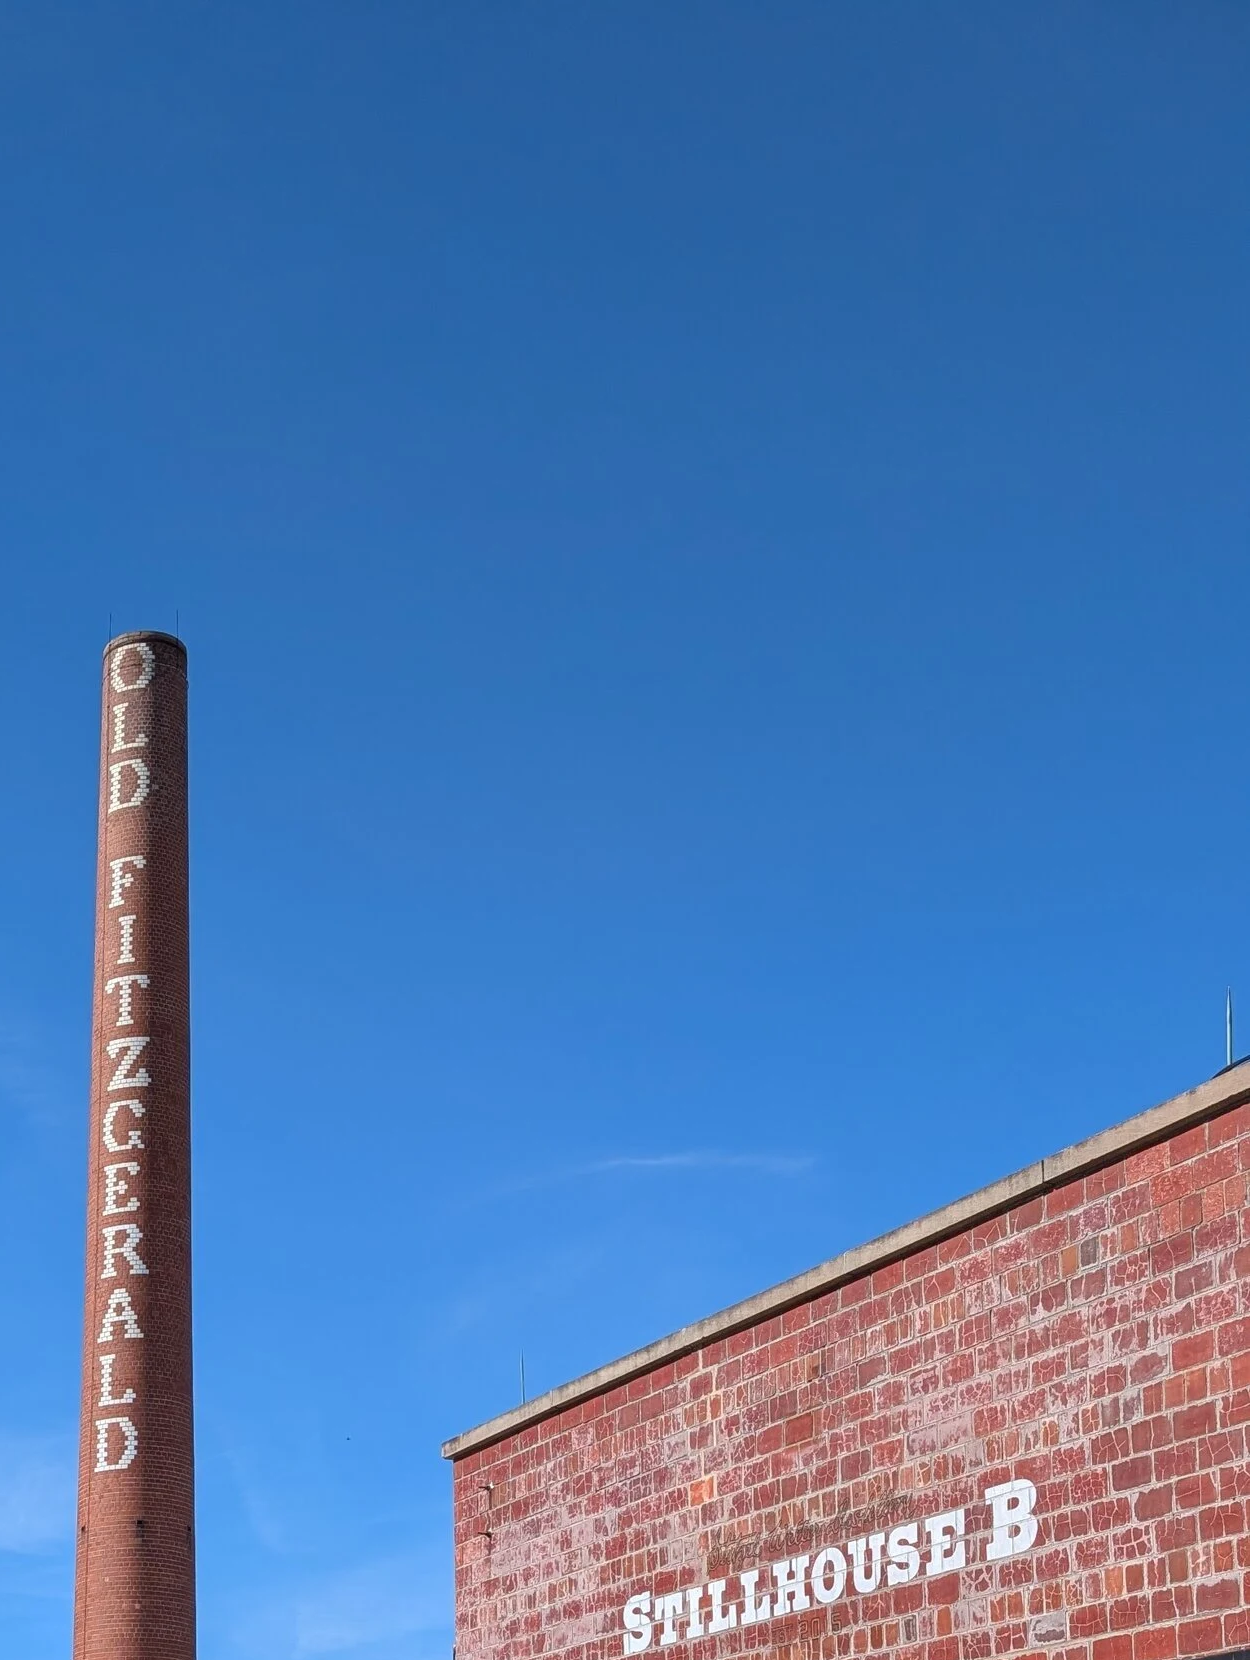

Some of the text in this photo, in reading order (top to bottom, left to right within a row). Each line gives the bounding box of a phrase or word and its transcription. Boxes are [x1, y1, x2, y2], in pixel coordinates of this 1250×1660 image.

[94, 642, 154, 1472] OLD FITZGERALD
[623, 1478, 1039, 1654] STILLHOUSE B
